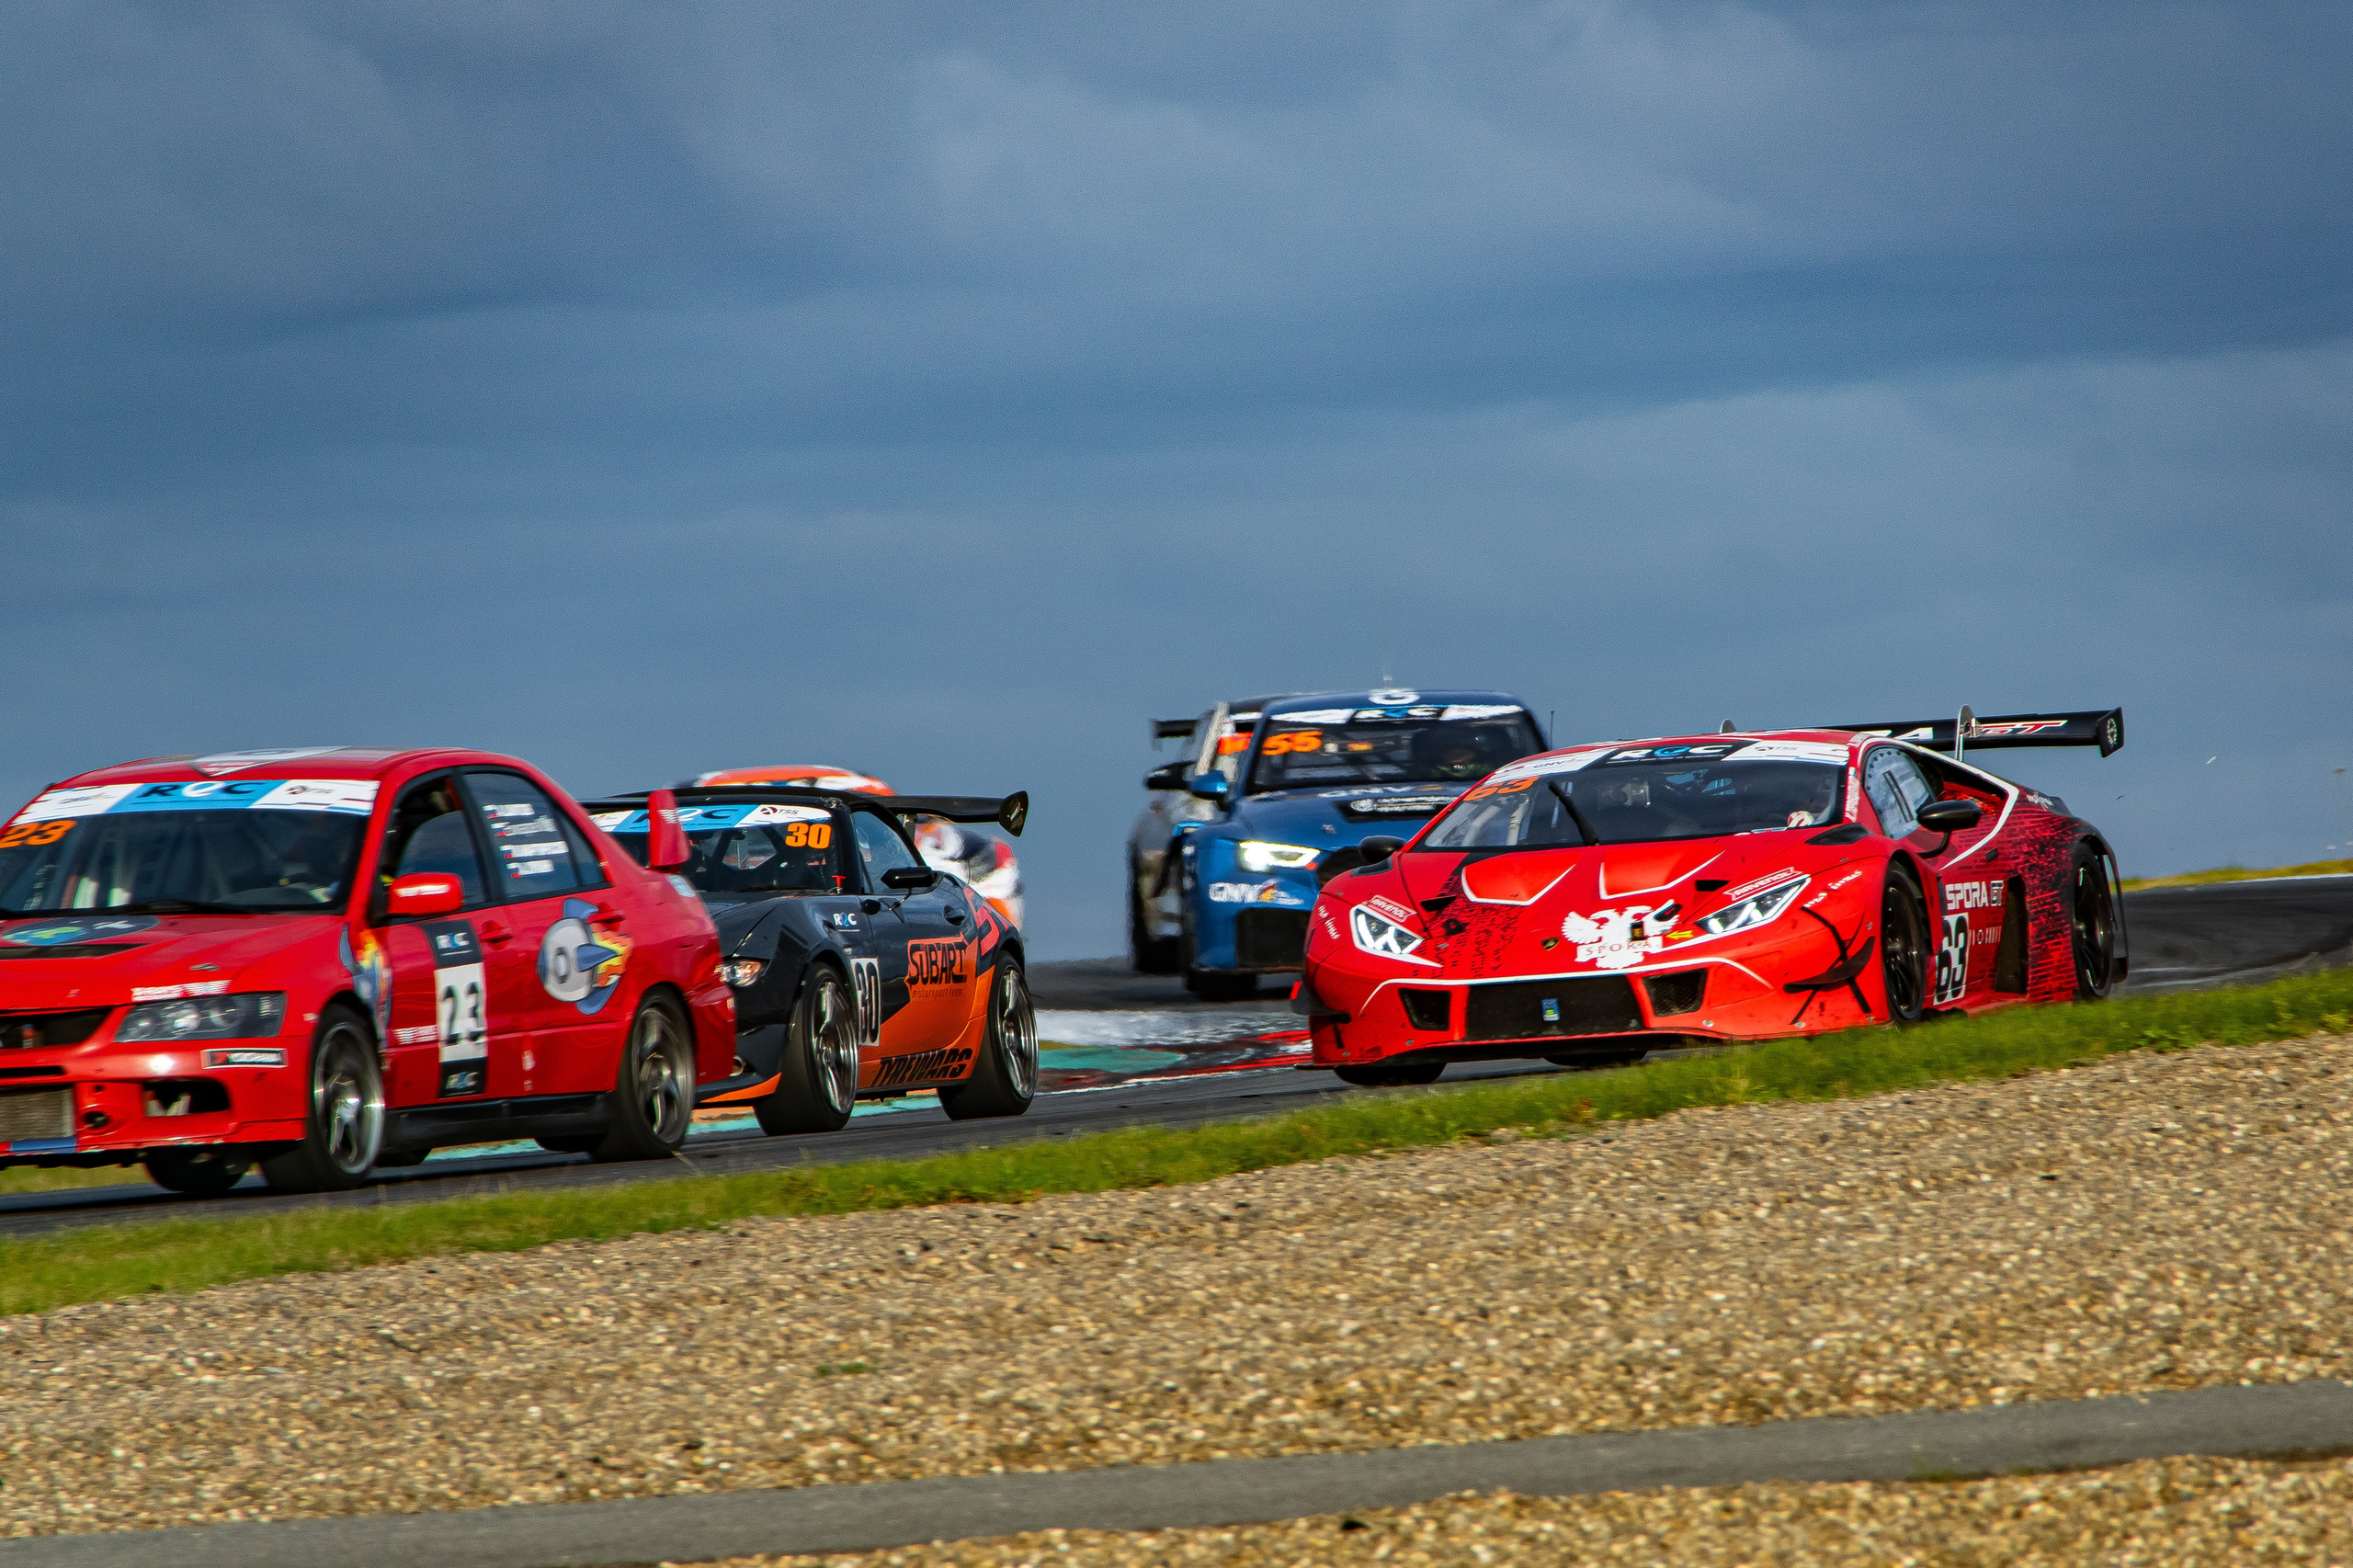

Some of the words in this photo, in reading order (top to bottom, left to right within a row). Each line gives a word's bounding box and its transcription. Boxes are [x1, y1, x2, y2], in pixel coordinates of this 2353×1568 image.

[1262, 732, 1323, 756] 55
[1462, 776, 1540, 801] 63
[0, 820, 77, 849] 23
[785, 823, 833, 849] 30
[1945, 881, 1989, 910] SPORA
[1586, 941, 1652, 956] SPORA
[1936, 915, 1968, 1003] 63
[441, 981, 486, 1044] 23
[854, 961, 880, 1043] 30
[870, 1048, 973, 1087] TYREWARS
